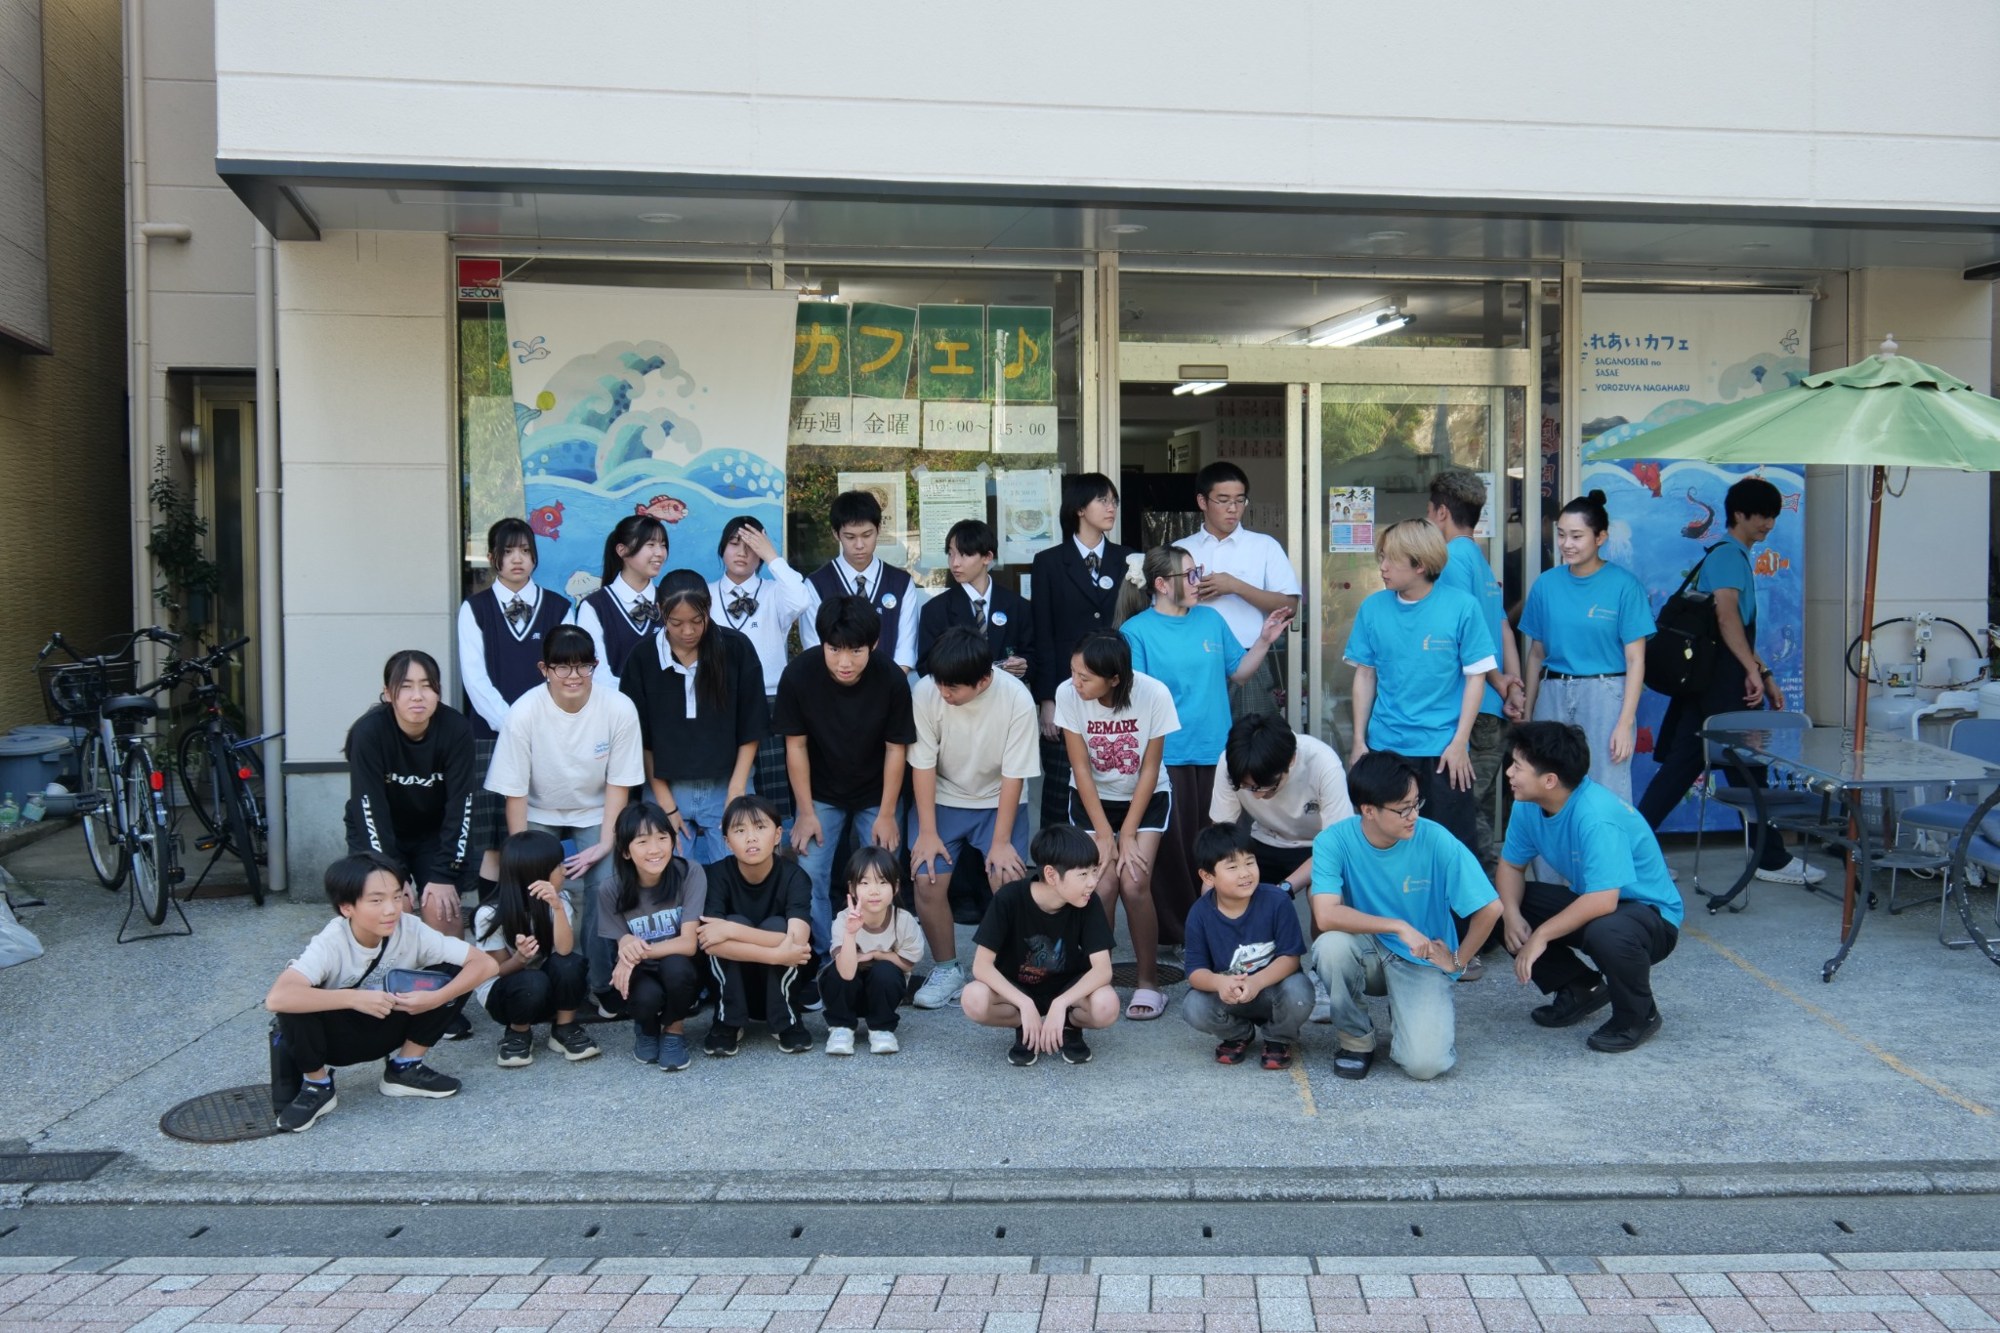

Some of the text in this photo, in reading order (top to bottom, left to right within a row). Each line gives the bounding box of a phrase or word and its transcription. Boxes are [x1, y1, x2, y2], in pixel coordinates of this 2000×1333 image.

[461, 288, 500, 298] SECOM
[1583, 333, 1689, 351] れあいカフェ
[1594, 357, 1649, 367] SAGANOSEKI
[1650, 359, 1662, 367] no
[1595, 368, 1620, 377] SASAE
[1595, 383, 1690, 392] YOROZUYA NAGAHARU
[1086, 718, 1139, 735] REMARK
[1087, 733, 1141, 775] 36
